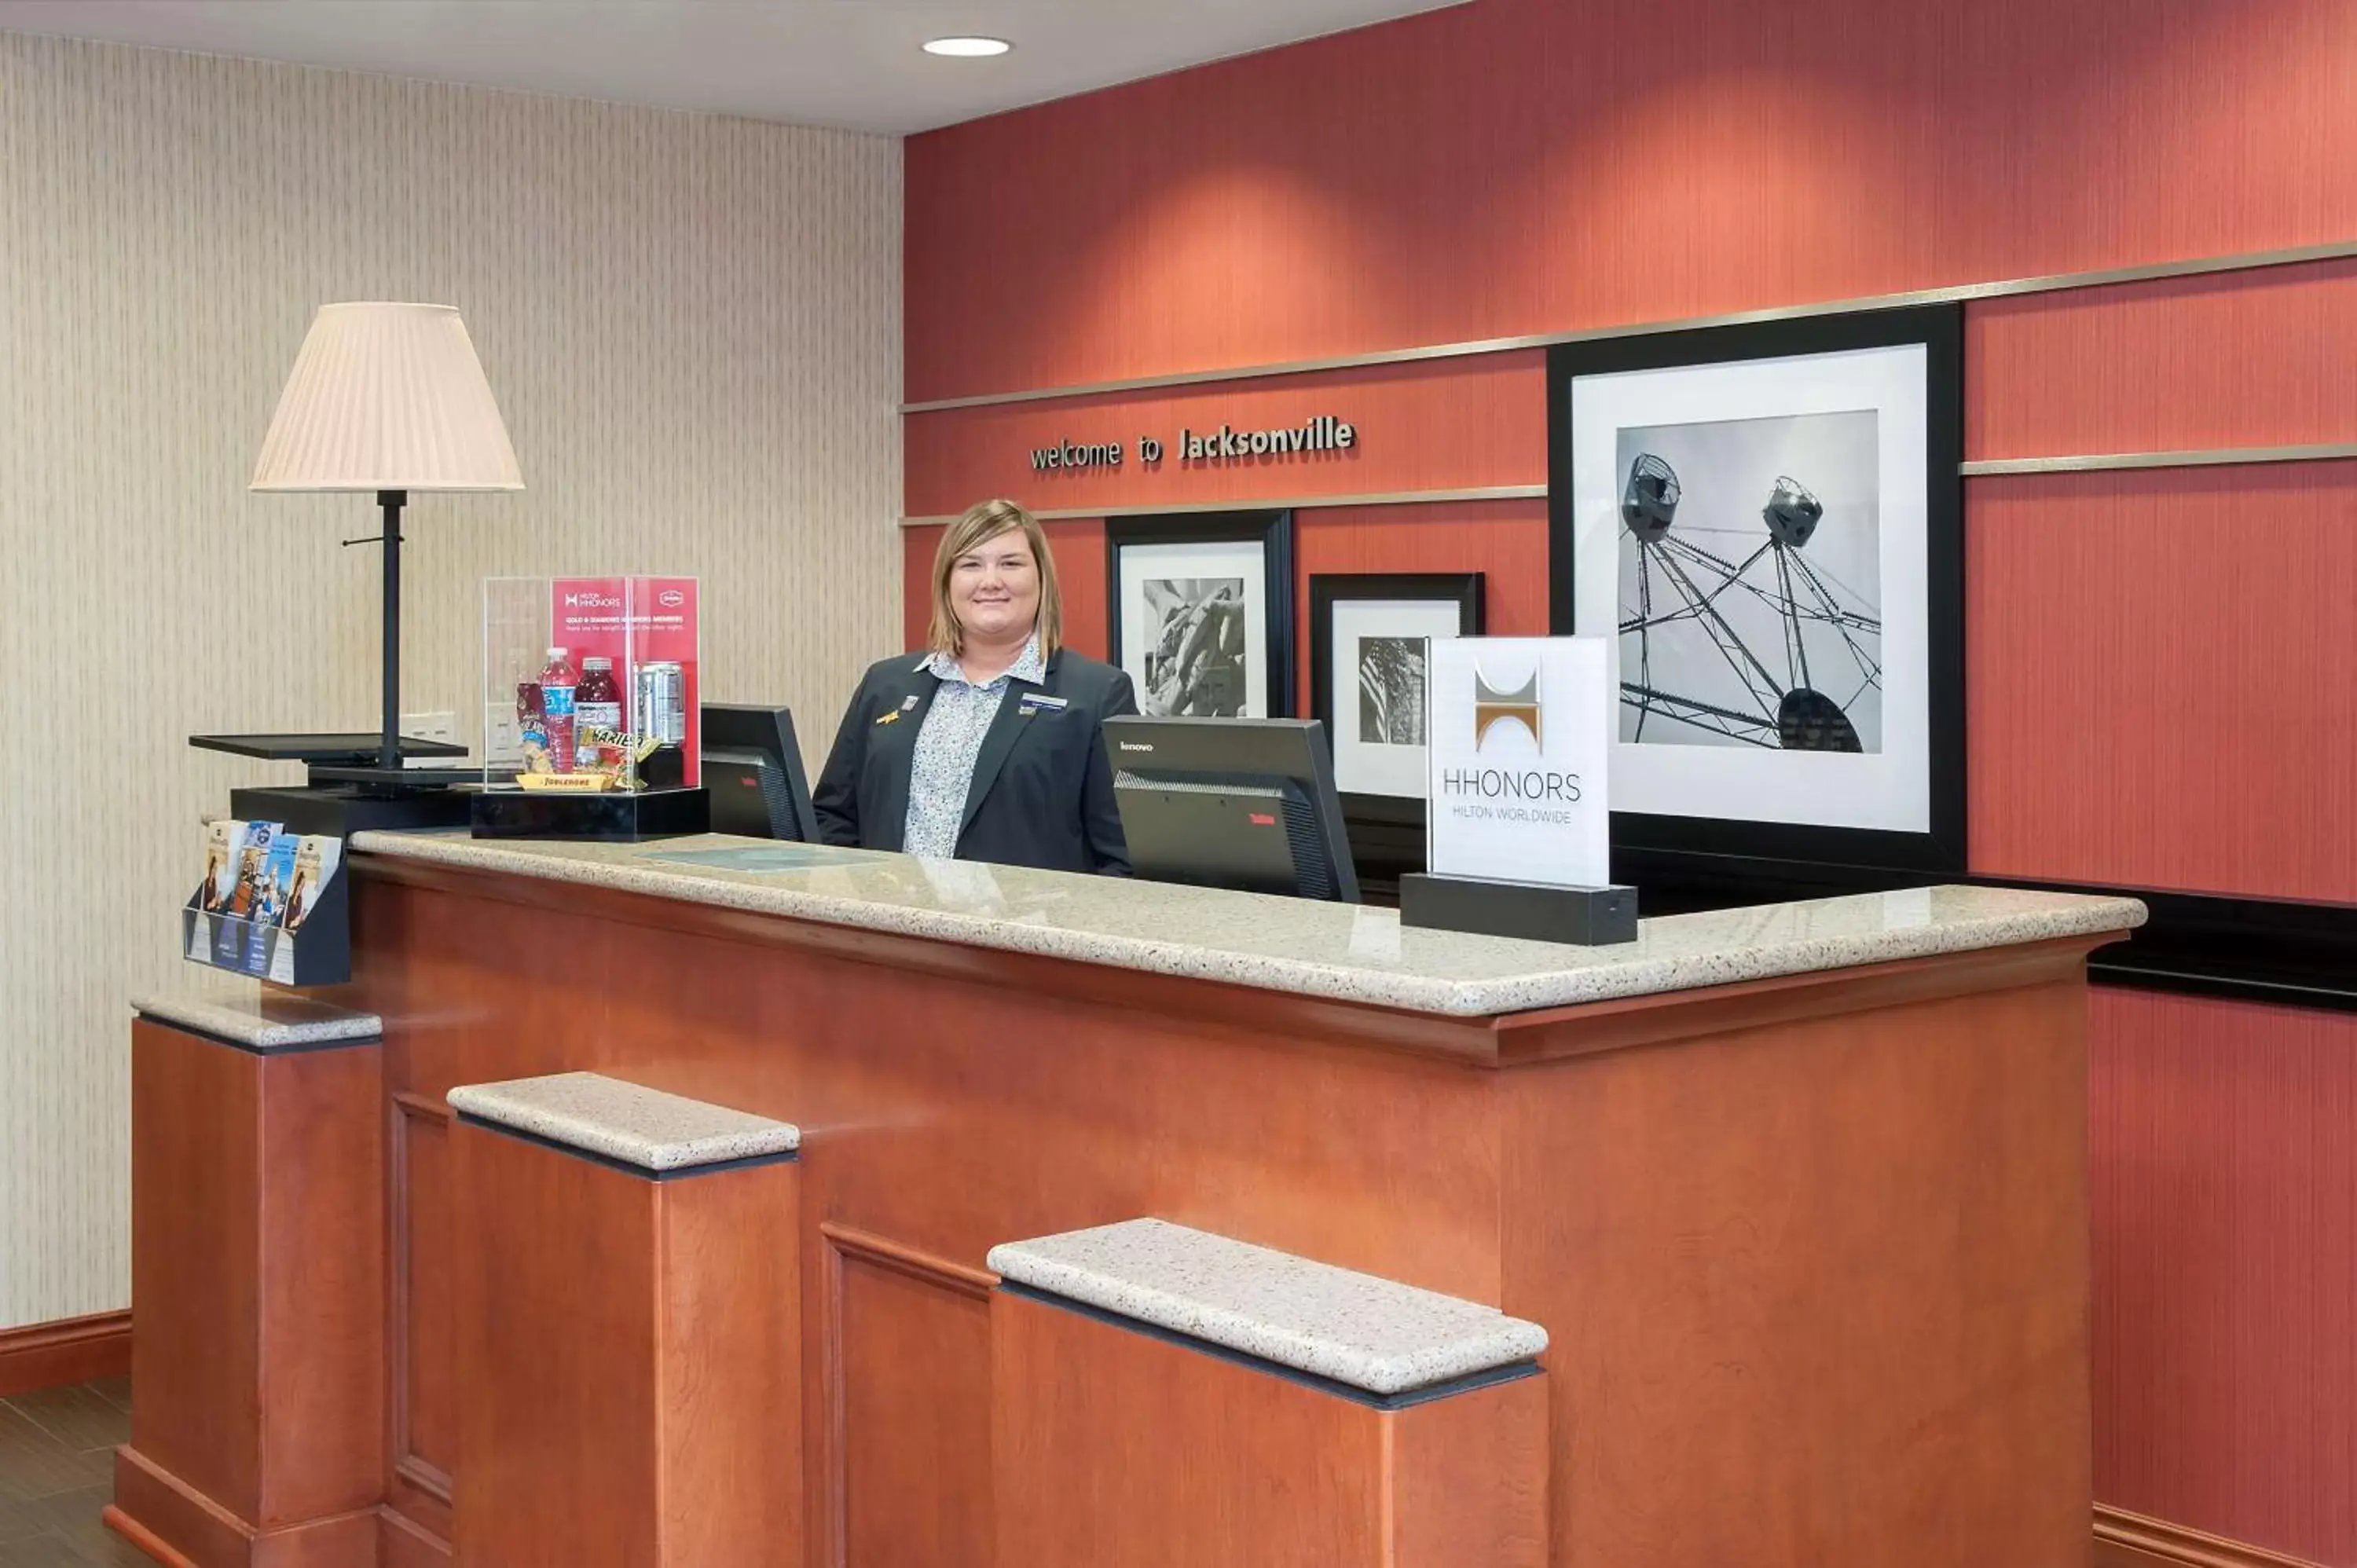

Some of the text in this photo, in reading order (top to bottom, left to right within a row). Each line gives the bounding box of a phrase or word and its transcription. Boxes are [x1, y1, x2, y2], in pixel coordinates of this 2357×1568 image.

[1031, 416, 1354, 469] welcome to Jacksonville
[1120, 741, 1154, 752] lenovo
[1444, 768, 1581, 801] HHONORS
[1453, 804, 1571, 825] HILTON WORLDWIDE
